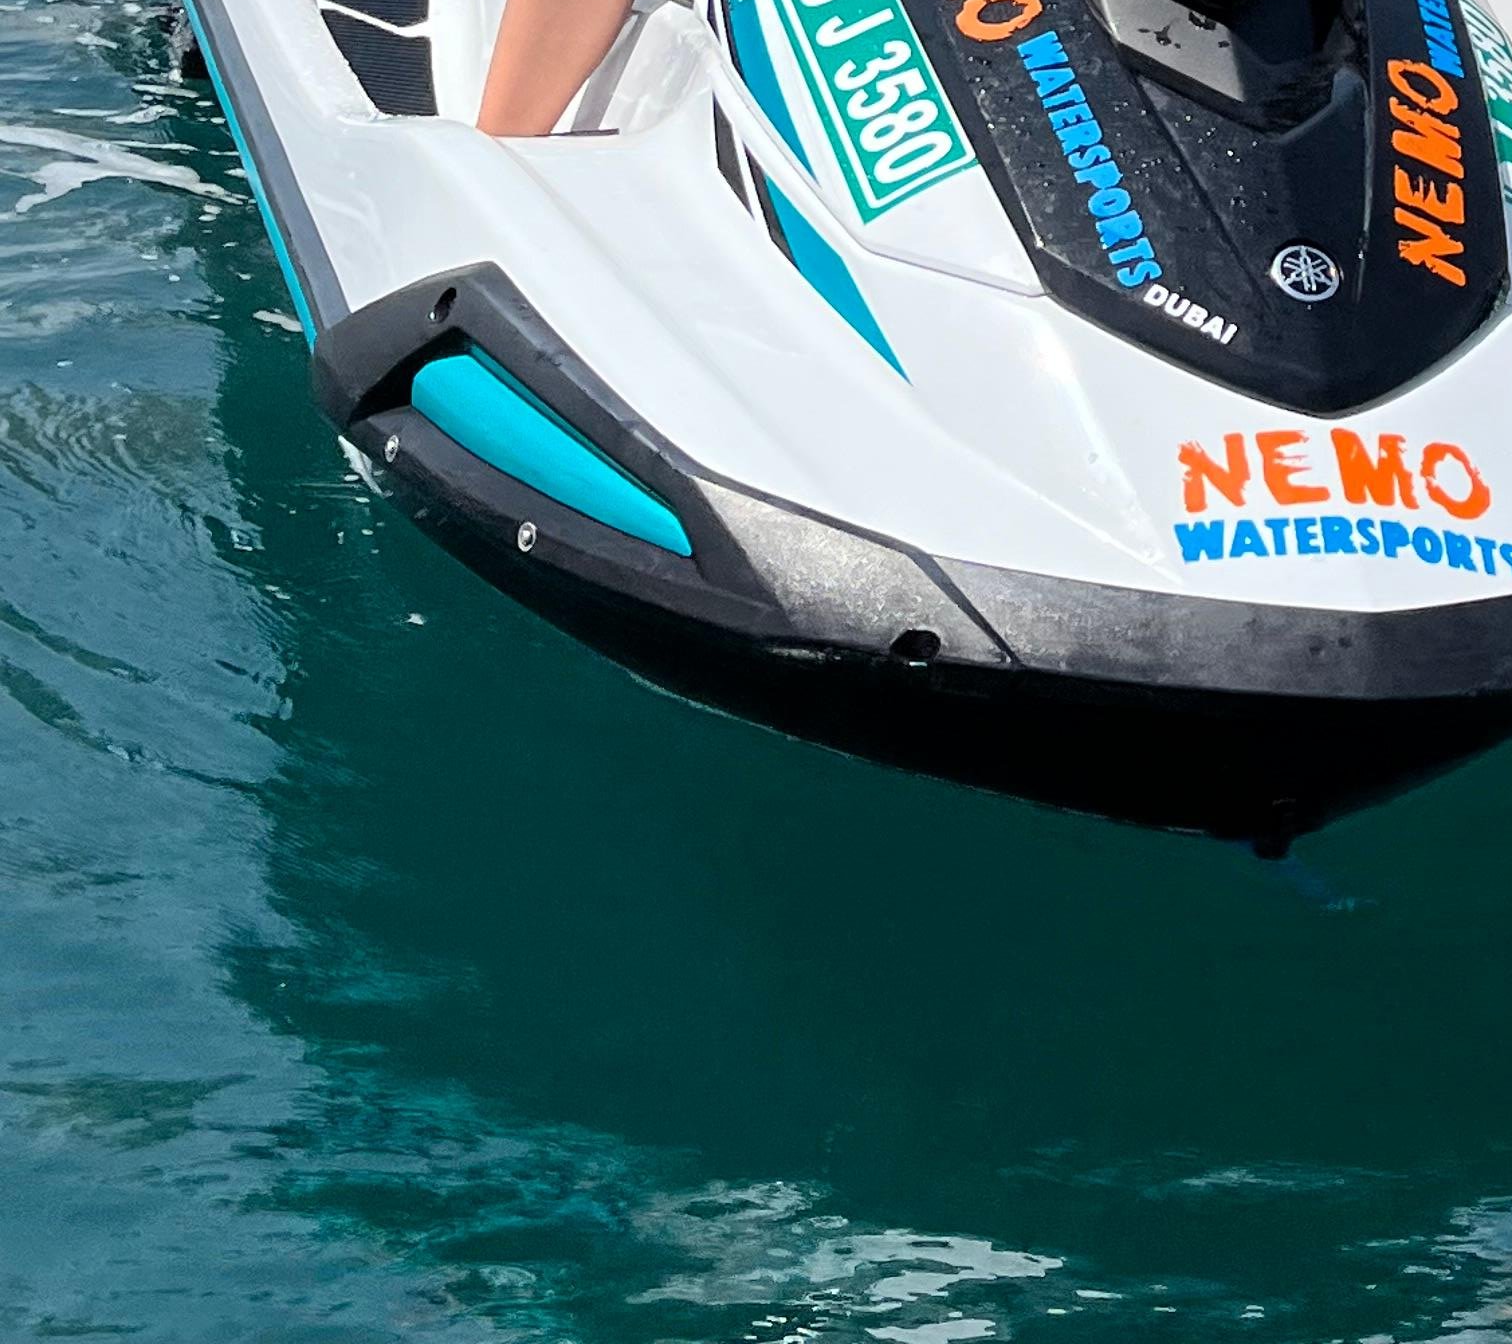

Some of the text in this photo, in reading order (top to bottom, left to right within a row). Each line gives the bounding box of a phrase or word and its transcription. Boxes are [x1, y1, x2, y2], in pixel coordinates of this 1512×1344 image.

[834, 40, 953, 184] 3580
[1016, 30, 1163, 287] WATERSPORTS
[1143, 283, 1238, 345] DUBAI
[1388, 59, 1467, 287] NEMO
[1177, 427, 1492, 521] NEMO
